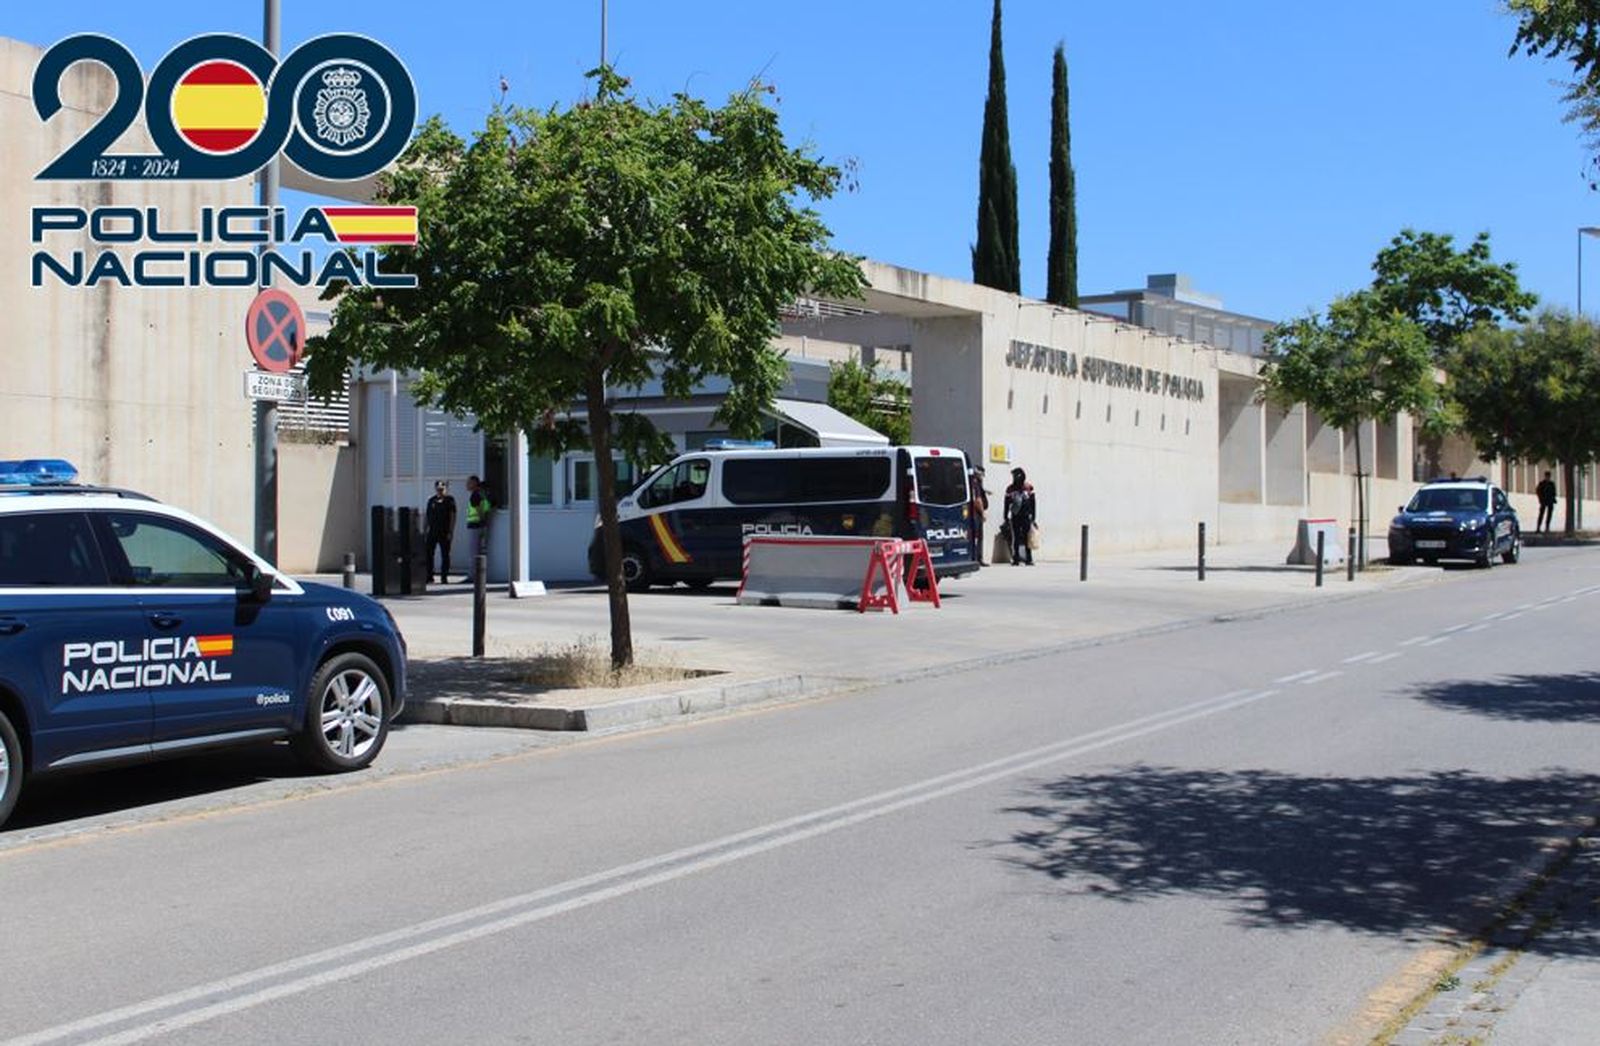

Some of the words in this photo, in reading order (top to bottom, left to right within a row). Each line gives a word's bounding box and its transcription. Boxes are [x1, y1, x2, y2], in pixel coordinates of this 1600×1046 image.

[1005, 339, 1078, 379] JEFATURA
[1081, 355, 1143, 392] SUPERIOR
[1144, 368, 1161, 395] DE
[257, 375, 282, 386] ZONA
[741, 523, 813, 536] POLICIA
[332, 607, 355, 621] 091
[62, 659, 232, 694] NACIONAL
